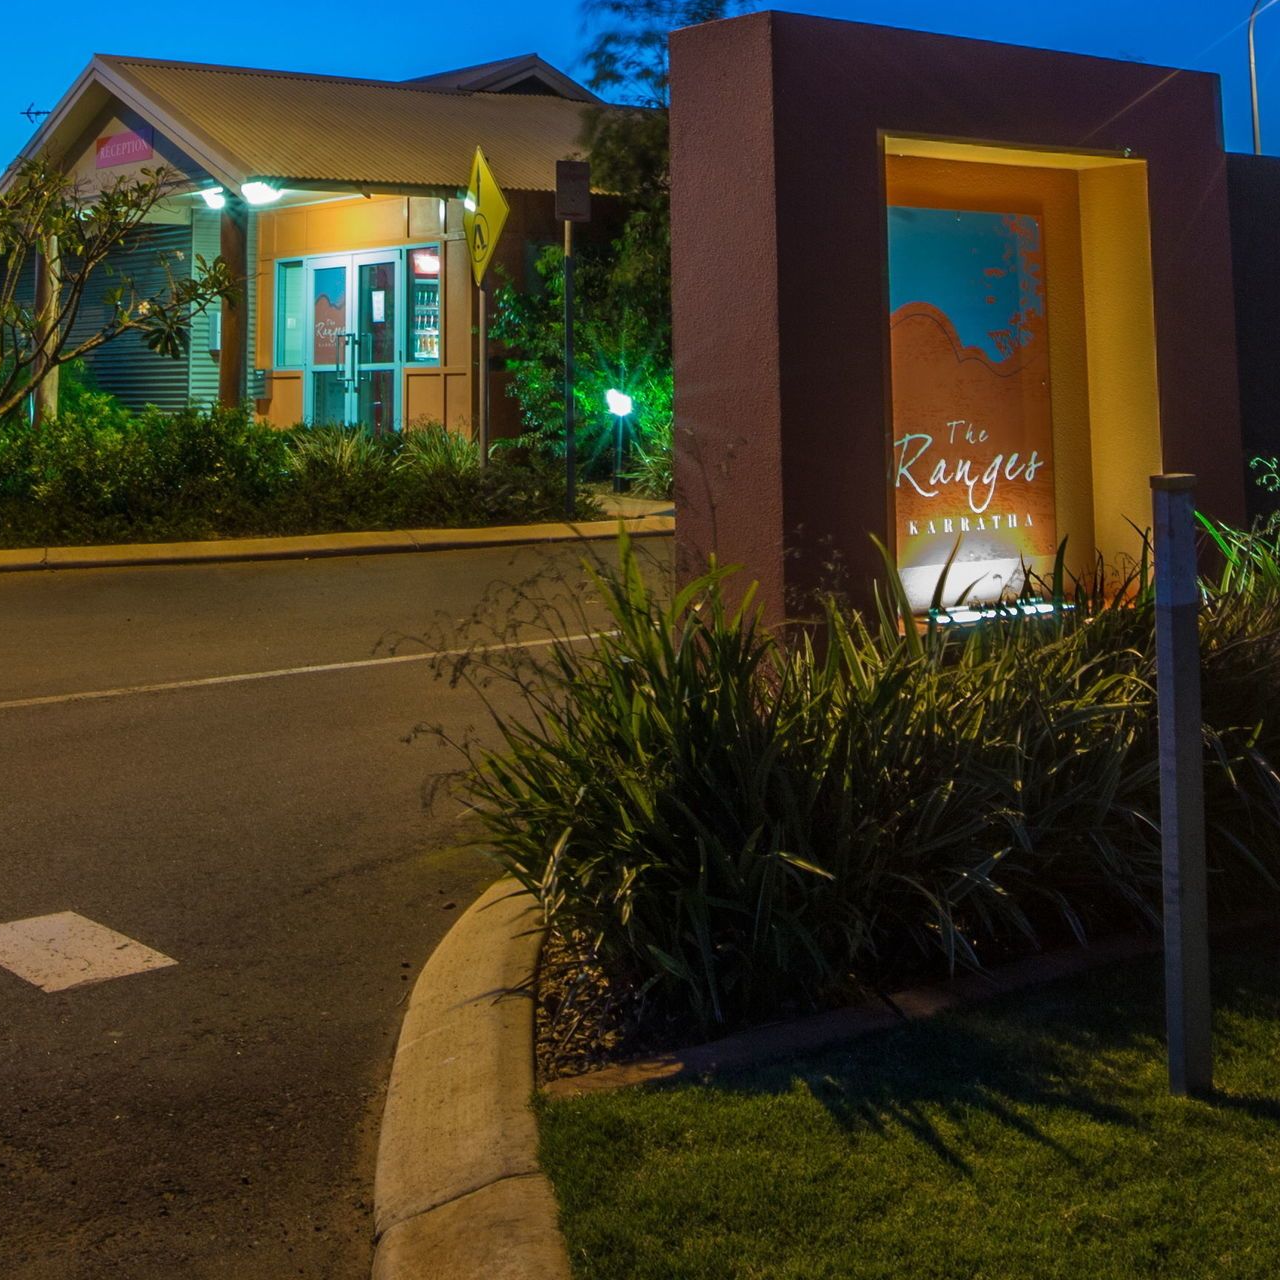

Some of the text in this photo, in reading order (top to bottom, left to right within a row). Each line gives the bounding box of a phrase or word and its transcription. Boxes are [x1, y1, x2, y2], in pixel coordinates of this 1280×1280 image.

[100, 138, 149, 160] RECEPTION
[947, 420, 989, 444] The
[894, 433, 1044, 513] Ranges
[908, 513, 1034, 536] KARRATHA
